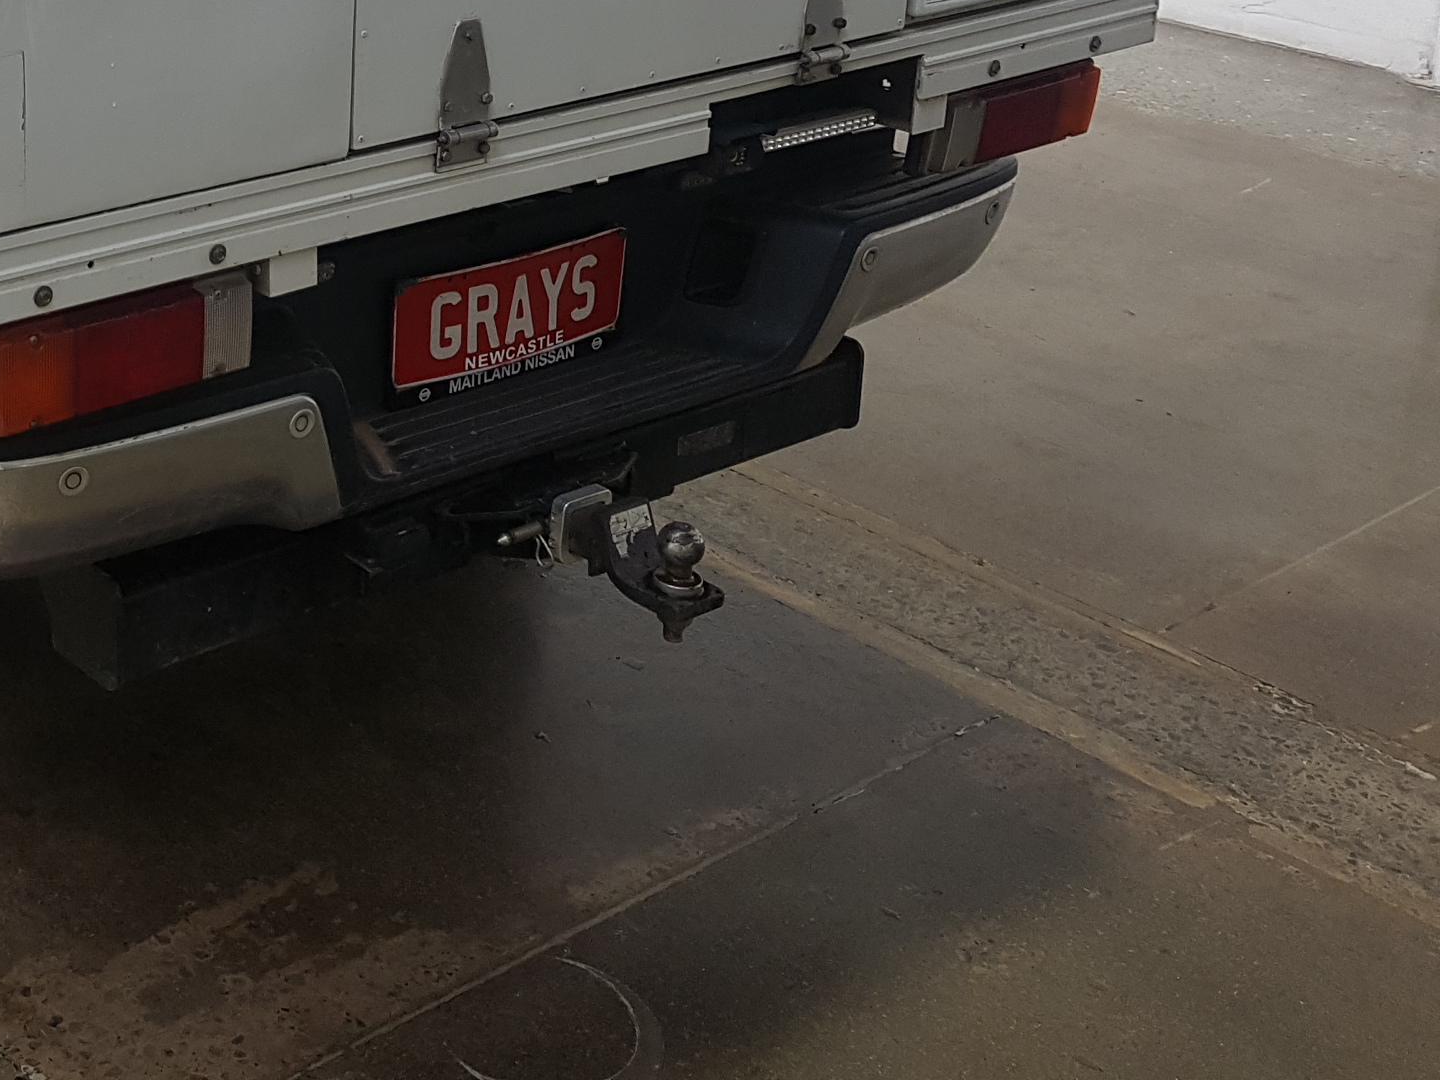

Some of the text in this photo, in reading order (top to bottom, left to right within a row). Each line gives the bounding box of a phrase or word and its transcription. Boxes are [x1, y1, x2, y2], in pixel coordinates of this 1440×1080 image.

[429, 253, 598, 360] GRAYS
[448, 344, 575, 394] MAITLAND NISSAN
[464, 329, 564, 371] NEWCASTLE
